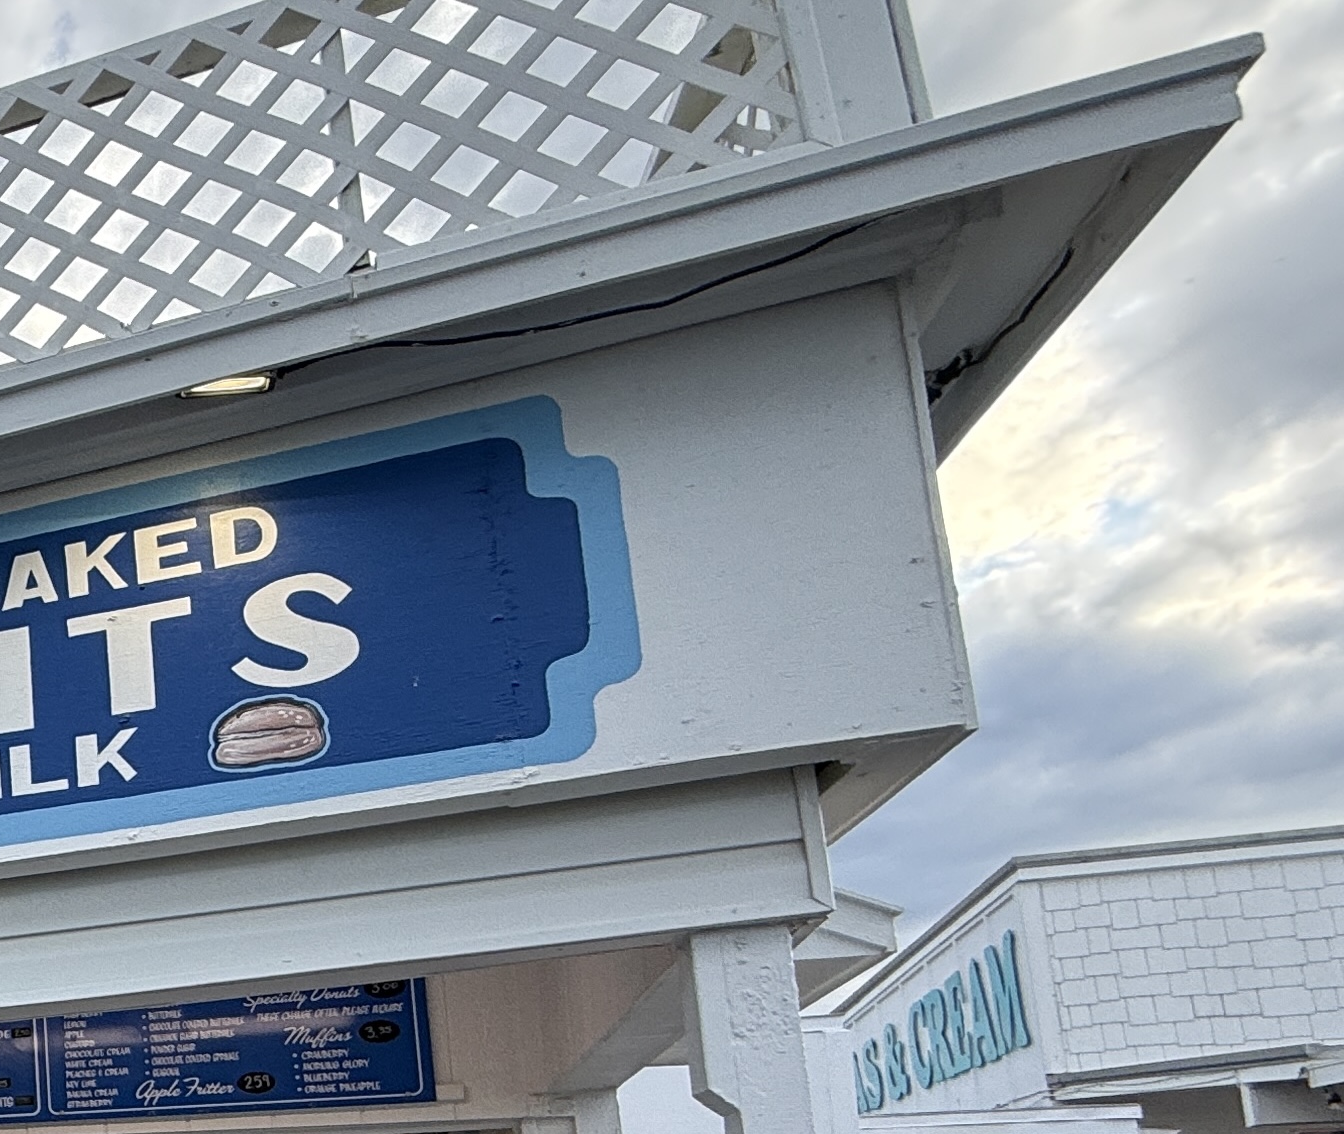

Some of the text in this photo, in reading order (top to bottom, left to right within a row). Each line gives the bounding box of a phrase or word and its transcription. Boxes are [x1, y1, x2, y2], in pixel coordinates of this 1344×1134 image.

[243, 986, 360, 1013] Specialty Donuts
[884, 1023, 911, 1101] &
[908, 929, 1031, 1089] CREAM
[284, 1026, 353, 1048] Muffins
[301, 1048, 349, 1060] CRANBERRY
[304, 1071, 351, 1082] BLUEBERRY
[136, 1079, 181, 1106] Apple
[182, 1077, 235, 1098] Fritter
